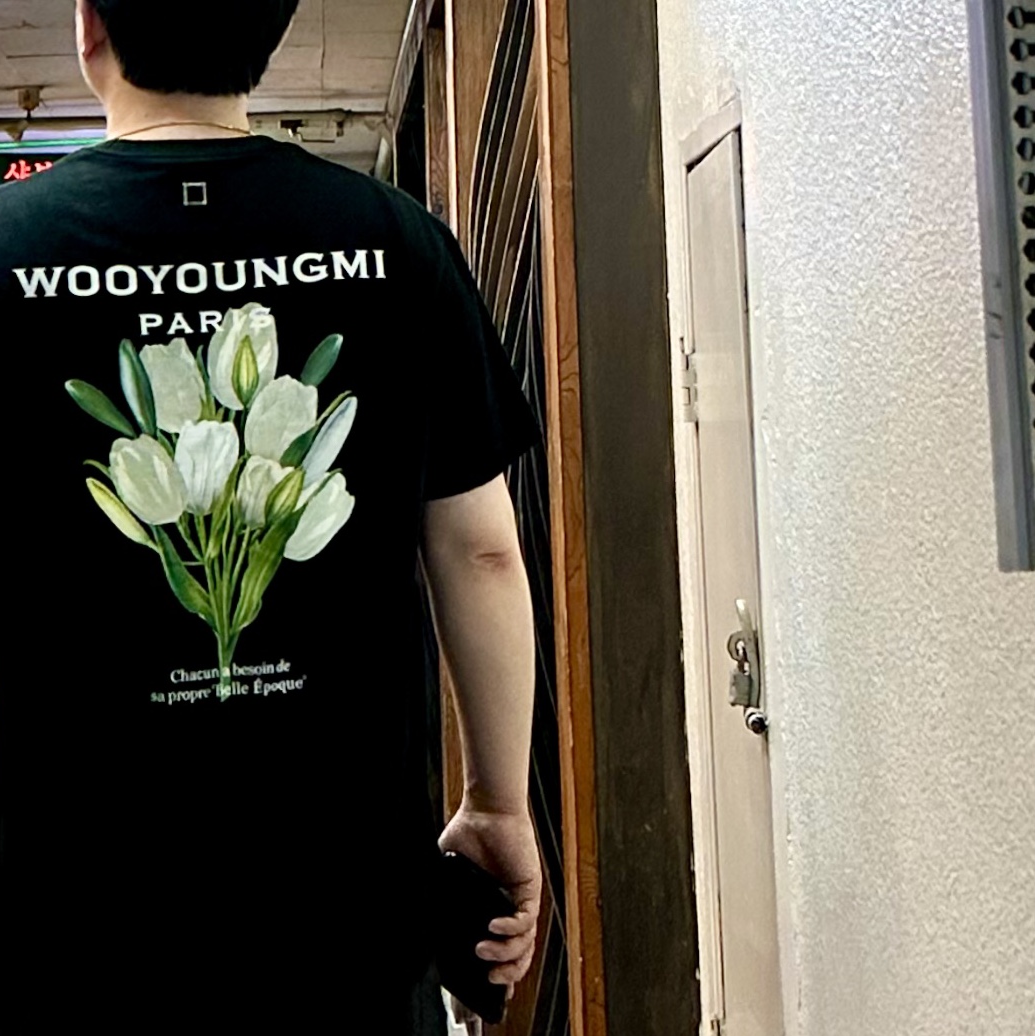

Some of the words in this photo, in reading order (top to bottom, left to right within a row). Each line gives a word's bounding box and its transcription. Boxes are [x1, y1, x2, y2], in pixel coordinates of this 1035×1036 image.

[11, 248, 387, 299] WOOYOUNGMI
[170, 667, 220, 684] Chacun
[232, 661, 275, 676] besoin
[276, 658, 291, 673] de
[150, 692, 166, 703] sa
[167, 688, 212, 706] propre
